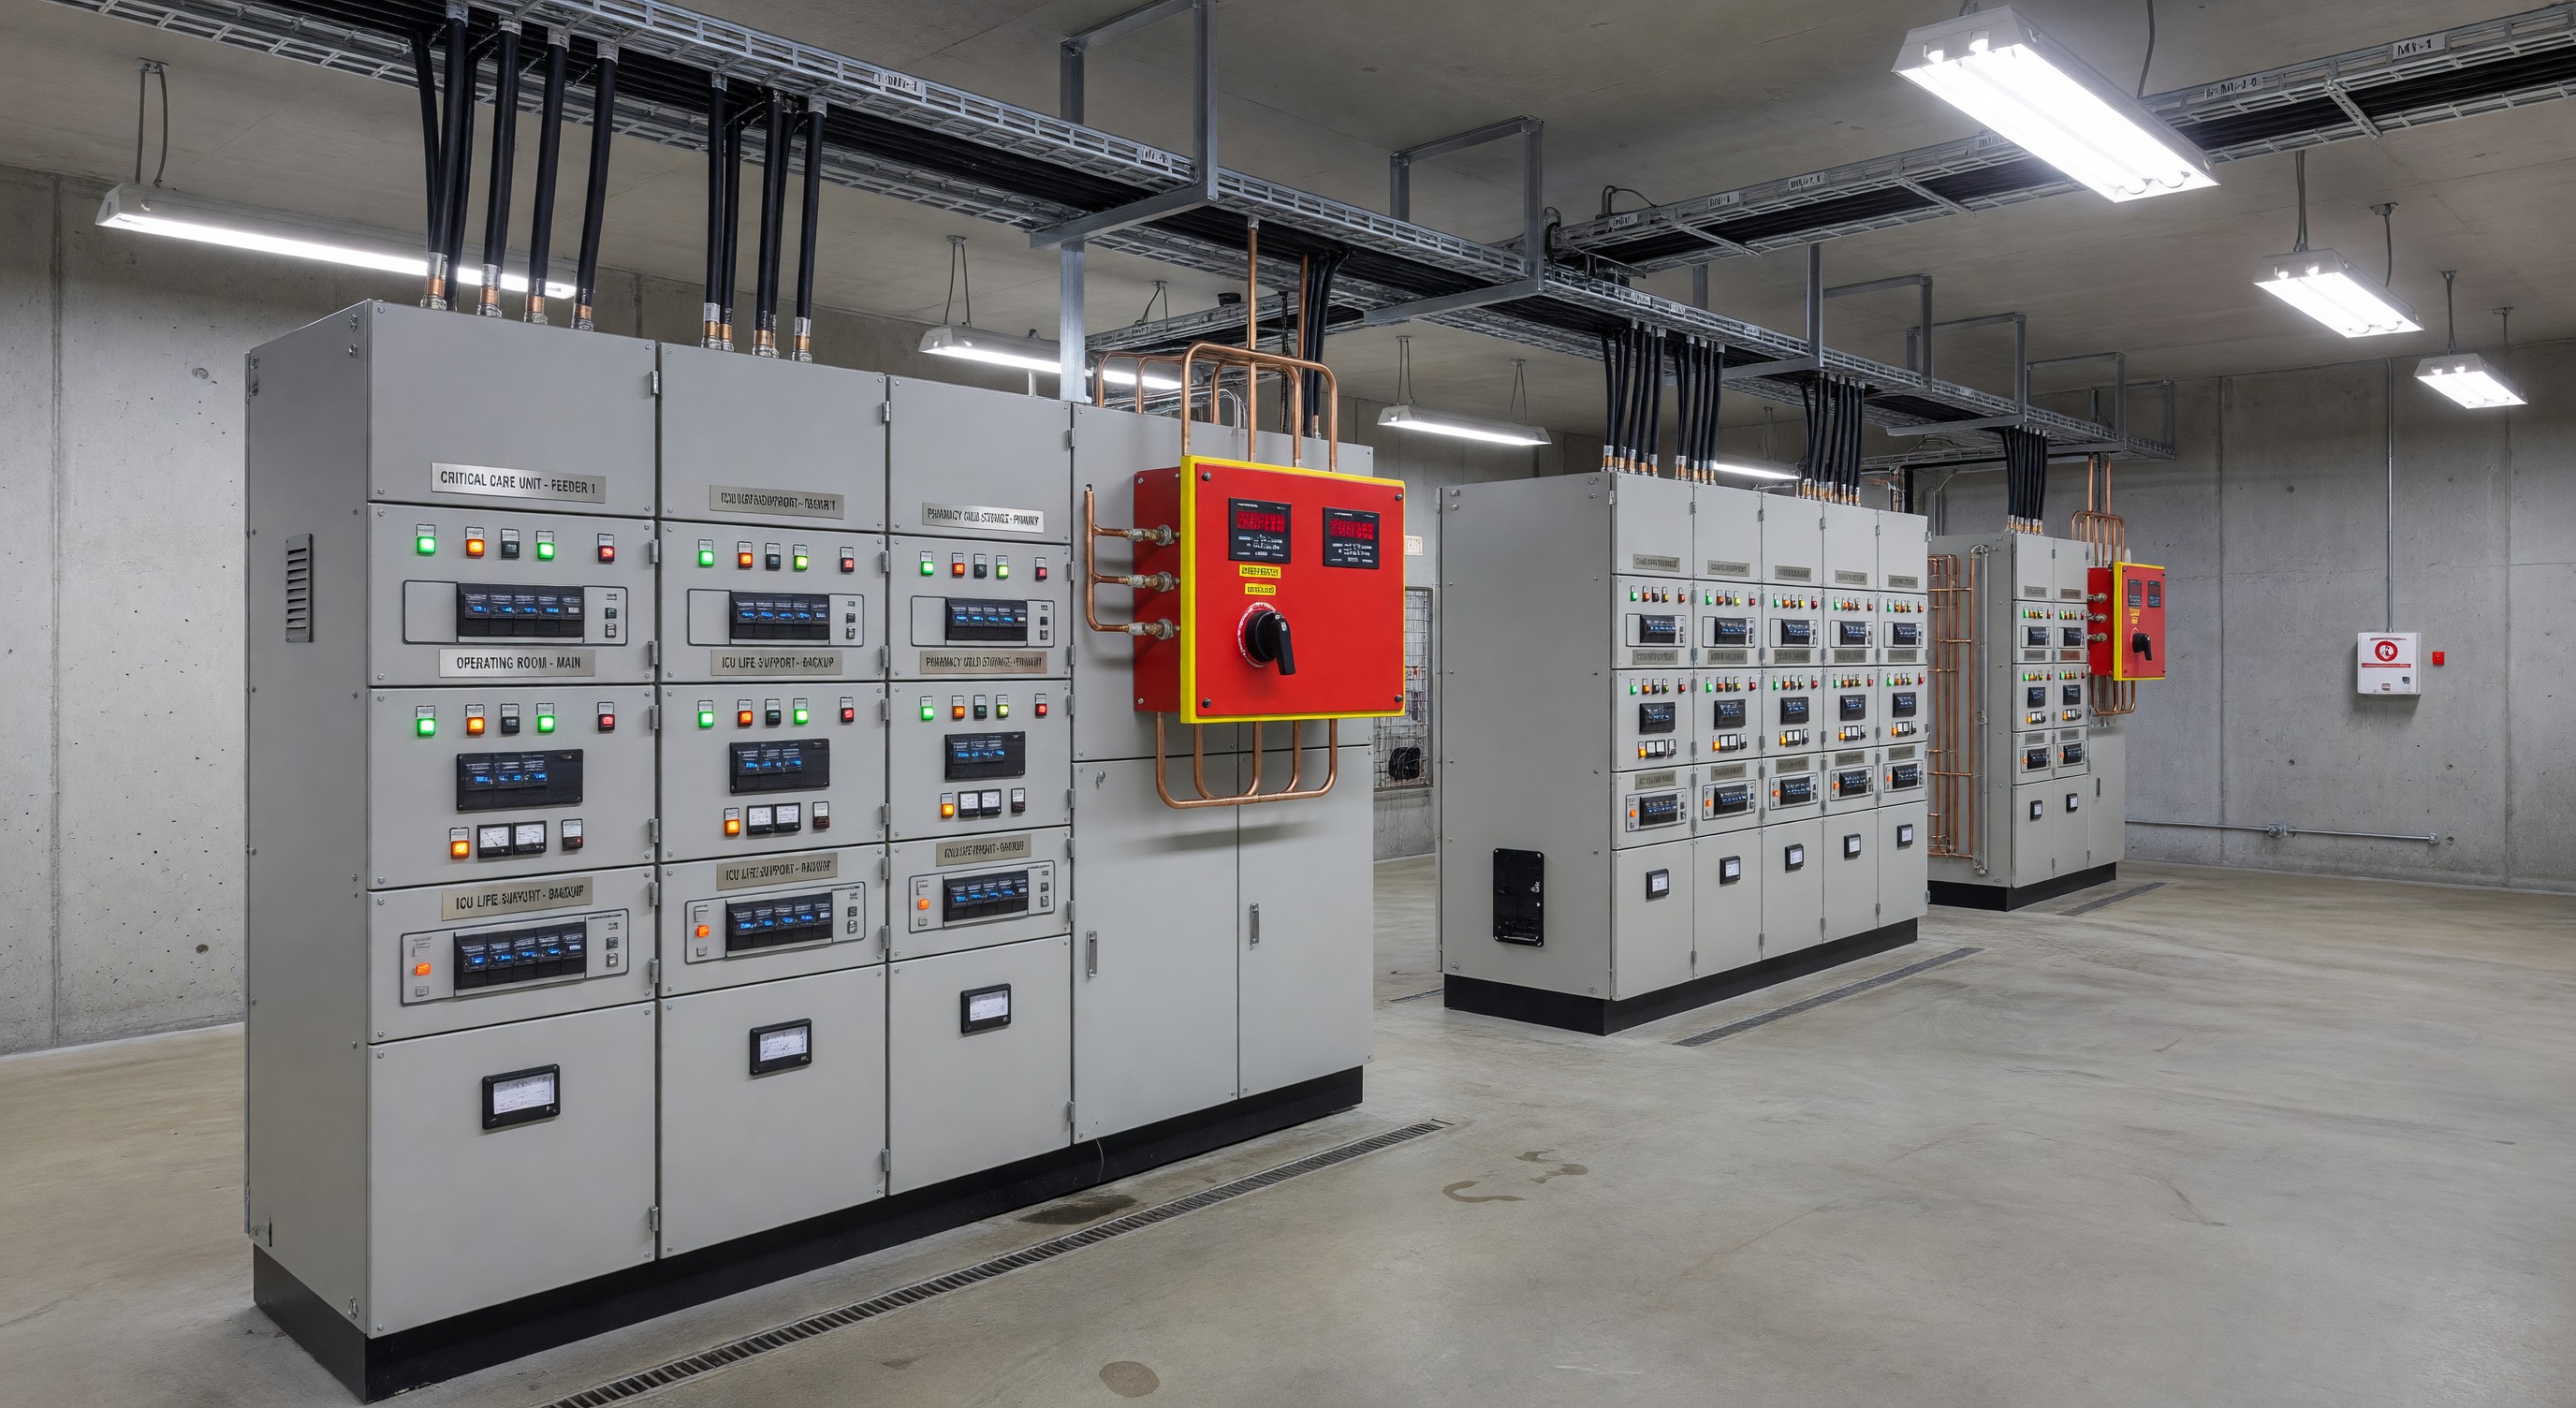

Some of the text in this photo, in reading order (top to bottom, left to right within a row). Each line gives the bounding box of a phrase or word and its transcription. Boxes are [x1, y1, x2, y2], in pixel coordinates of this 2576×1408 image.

[440, 470, 488, 487] CRITICAL
[490, 474, 516, 489] CARE
[519, 477, 542, 491] UNIT
[456, 656, 514, 669] OPERATING
[517, 656, 547, 669] ROOM
[556, 656, 581, 668] MAIN
[722, 656, 736, 668] ICU
[739, 656, 755, 668] LIFE
[456, 896, 474, 910] ICU
